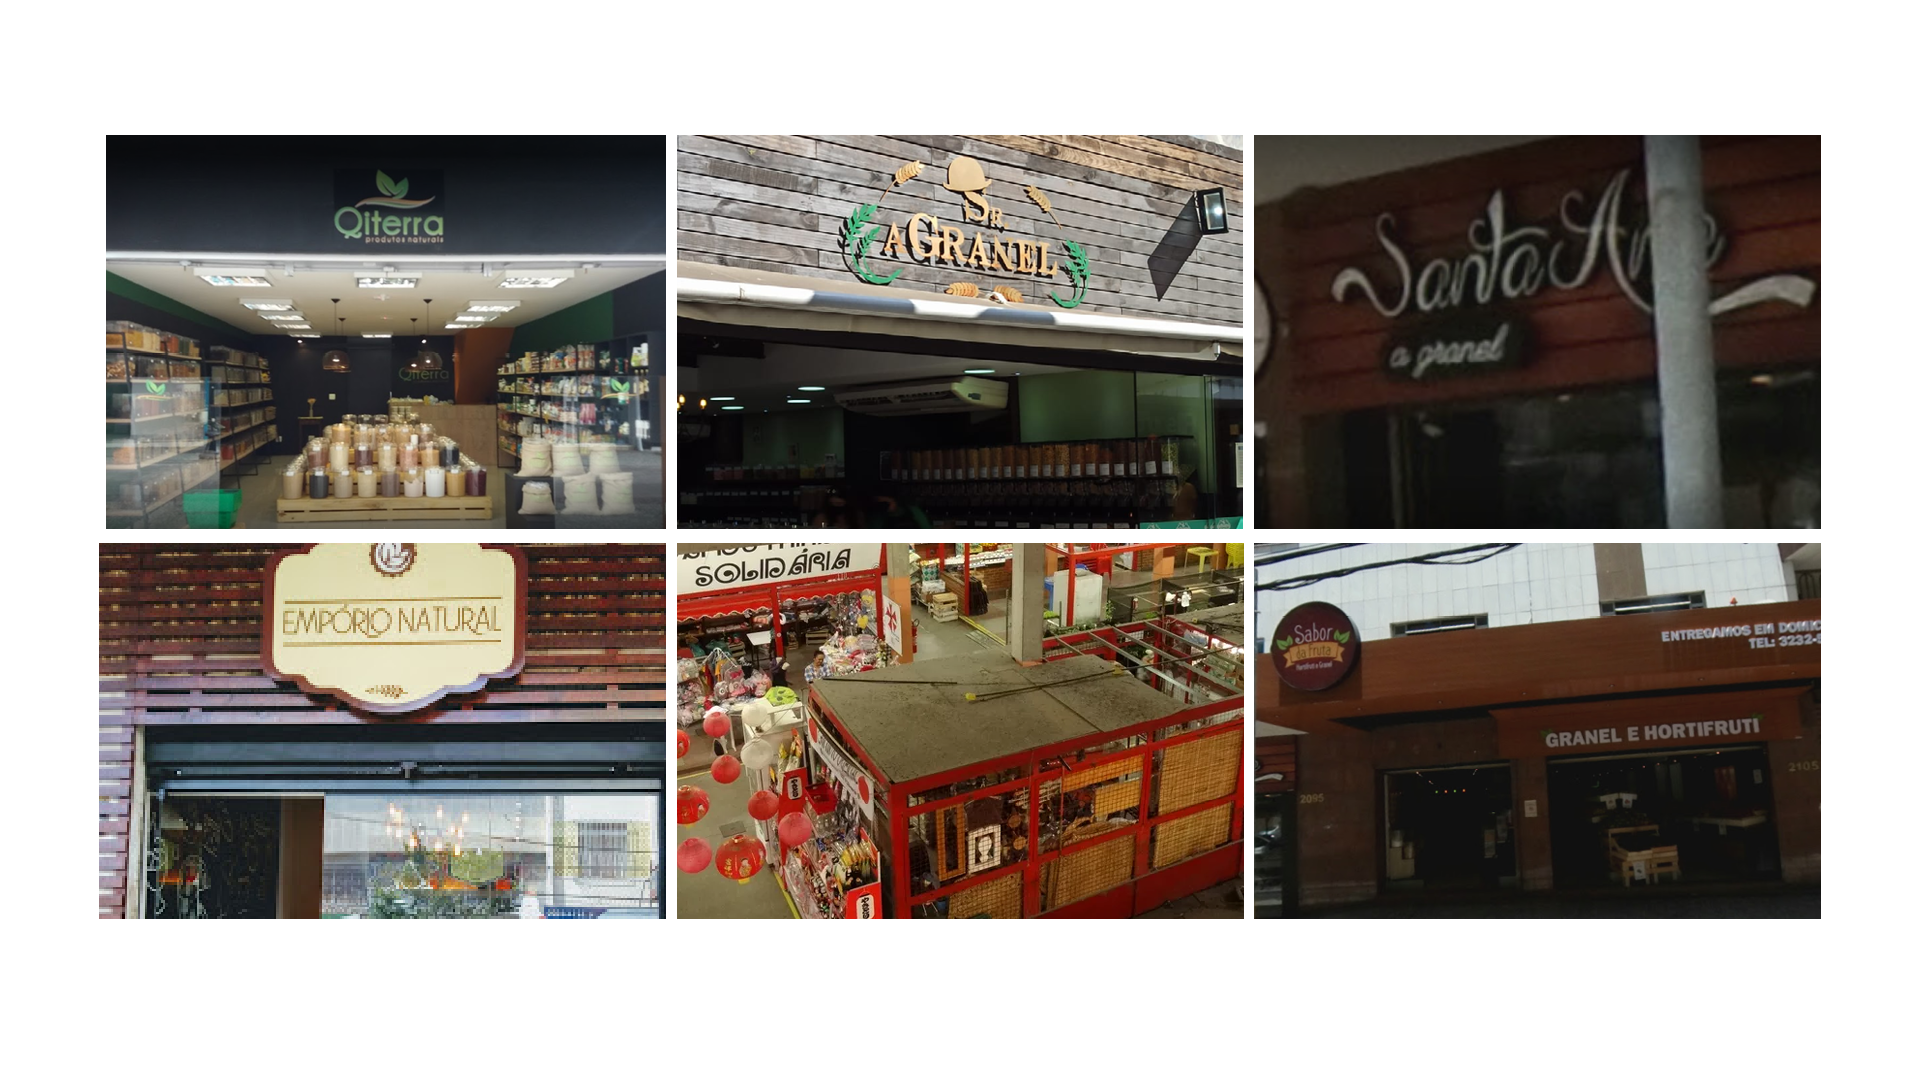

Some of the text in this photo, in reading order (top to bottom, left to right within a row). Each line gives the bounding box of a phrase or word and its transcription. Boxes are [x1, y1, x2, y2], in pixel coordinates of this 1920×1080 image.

[334, 206, 444, 239] Qiterra
[365, 236, 405, 244] produtos
[1331, 189, 1549, 317] Santa
[1389, 323, 1508, 381] a granel
[695, 548, 851, 587] SOLIDÁRIA
[283, 603, 502, 638] EMPÓRIO NATURAL
[1294, 622, 1333, 645] Sabor
[1661, 625, 1751, 642] ENTREGAMOS
[1754, 623, 1775, 635] EM
[1296, 646, 1307, 660] da
[1749, 638, 1775, 649] TEL:
[1545, 717, 1761, 748] GRANEL E HORTIFRUTI
[1788, 760, 1820, 771] 2105
